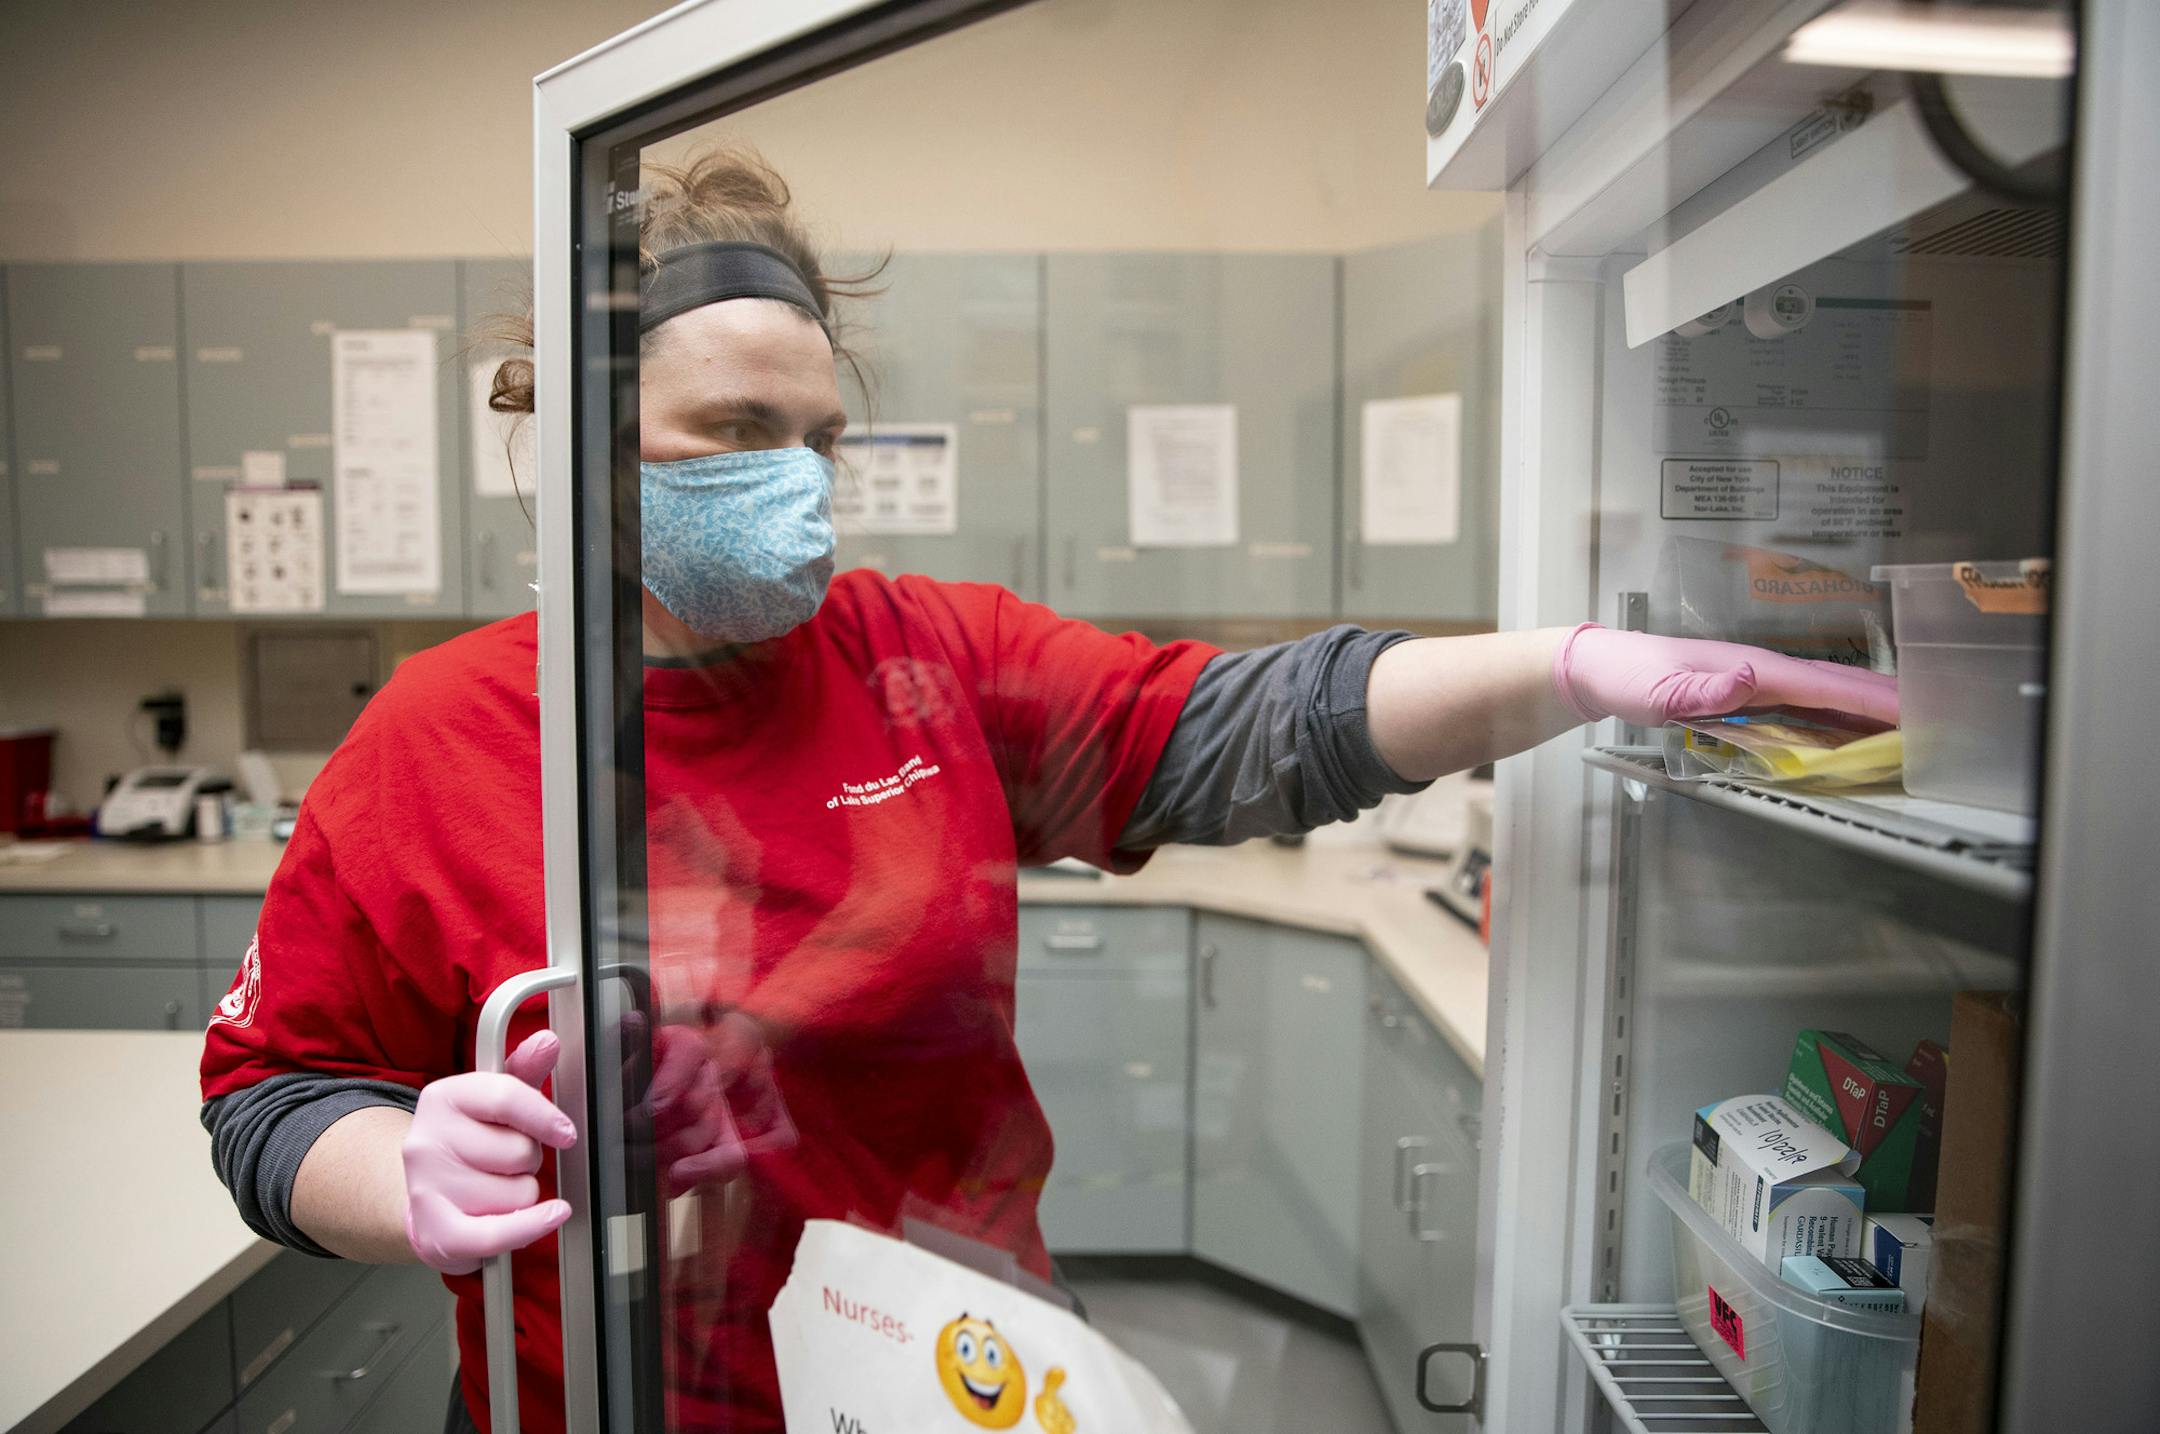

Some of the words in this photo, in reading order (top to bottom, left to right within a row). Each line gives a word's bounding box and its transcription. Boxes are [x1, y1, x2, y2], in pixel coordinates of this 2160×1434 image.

[1503, 19, 1514, 47] Not
[1513, 3, 1529, 34] Store
[1689, 464, 1724, 474] Accepted
[1725, 465, 1737, 473] for
[1831, 466, 1884, 480] NOTICE
[1689, 474, 1705, 484] City
[1706, 475, 1715, 483] of
[1715, 475, 1732, 483] New
[1733, 476, 1751, 484] York
[1674, 484, 1719, 495] Department
[1720, 485, 1729, 493] of
[1729, 485, 1766, 496] Buildings
[1816, 483, 1836, 493] This
[1837, 483, 1889, 495] Equipment
[1890, 484, 1900, 494] is
[1694, 495, 1712, 504] MEA
[1871, 495, 1885, 505] for
[1811, 506, 1856, 517] operation
[1857, 506, 1868, 516] in
[1869, 508, 1881, 516] an
[1883, 508, 1903, 517] area
[1821, 518, 1831, 528] of
[1812, 530, 1868, 541] temperature
[1869, 531, 1881, 540] or
[1882, 530, 1902, 540] less
[864, 780, 880, 792] du
[879, 775, 901, 788] Lac
[826, 795, 840, 810] of
[860, 784, 905, 805] Superior
[1842, 1076, 1867, 1101] DTaP
[1873, 1089, 1890, 1129] DTaP
[1817, 1216, 1828, 1247] 9-valent
[1829, 1216, 1839, 1242] Human
[1794, 1215, 1806, 1257] GARDASIL
